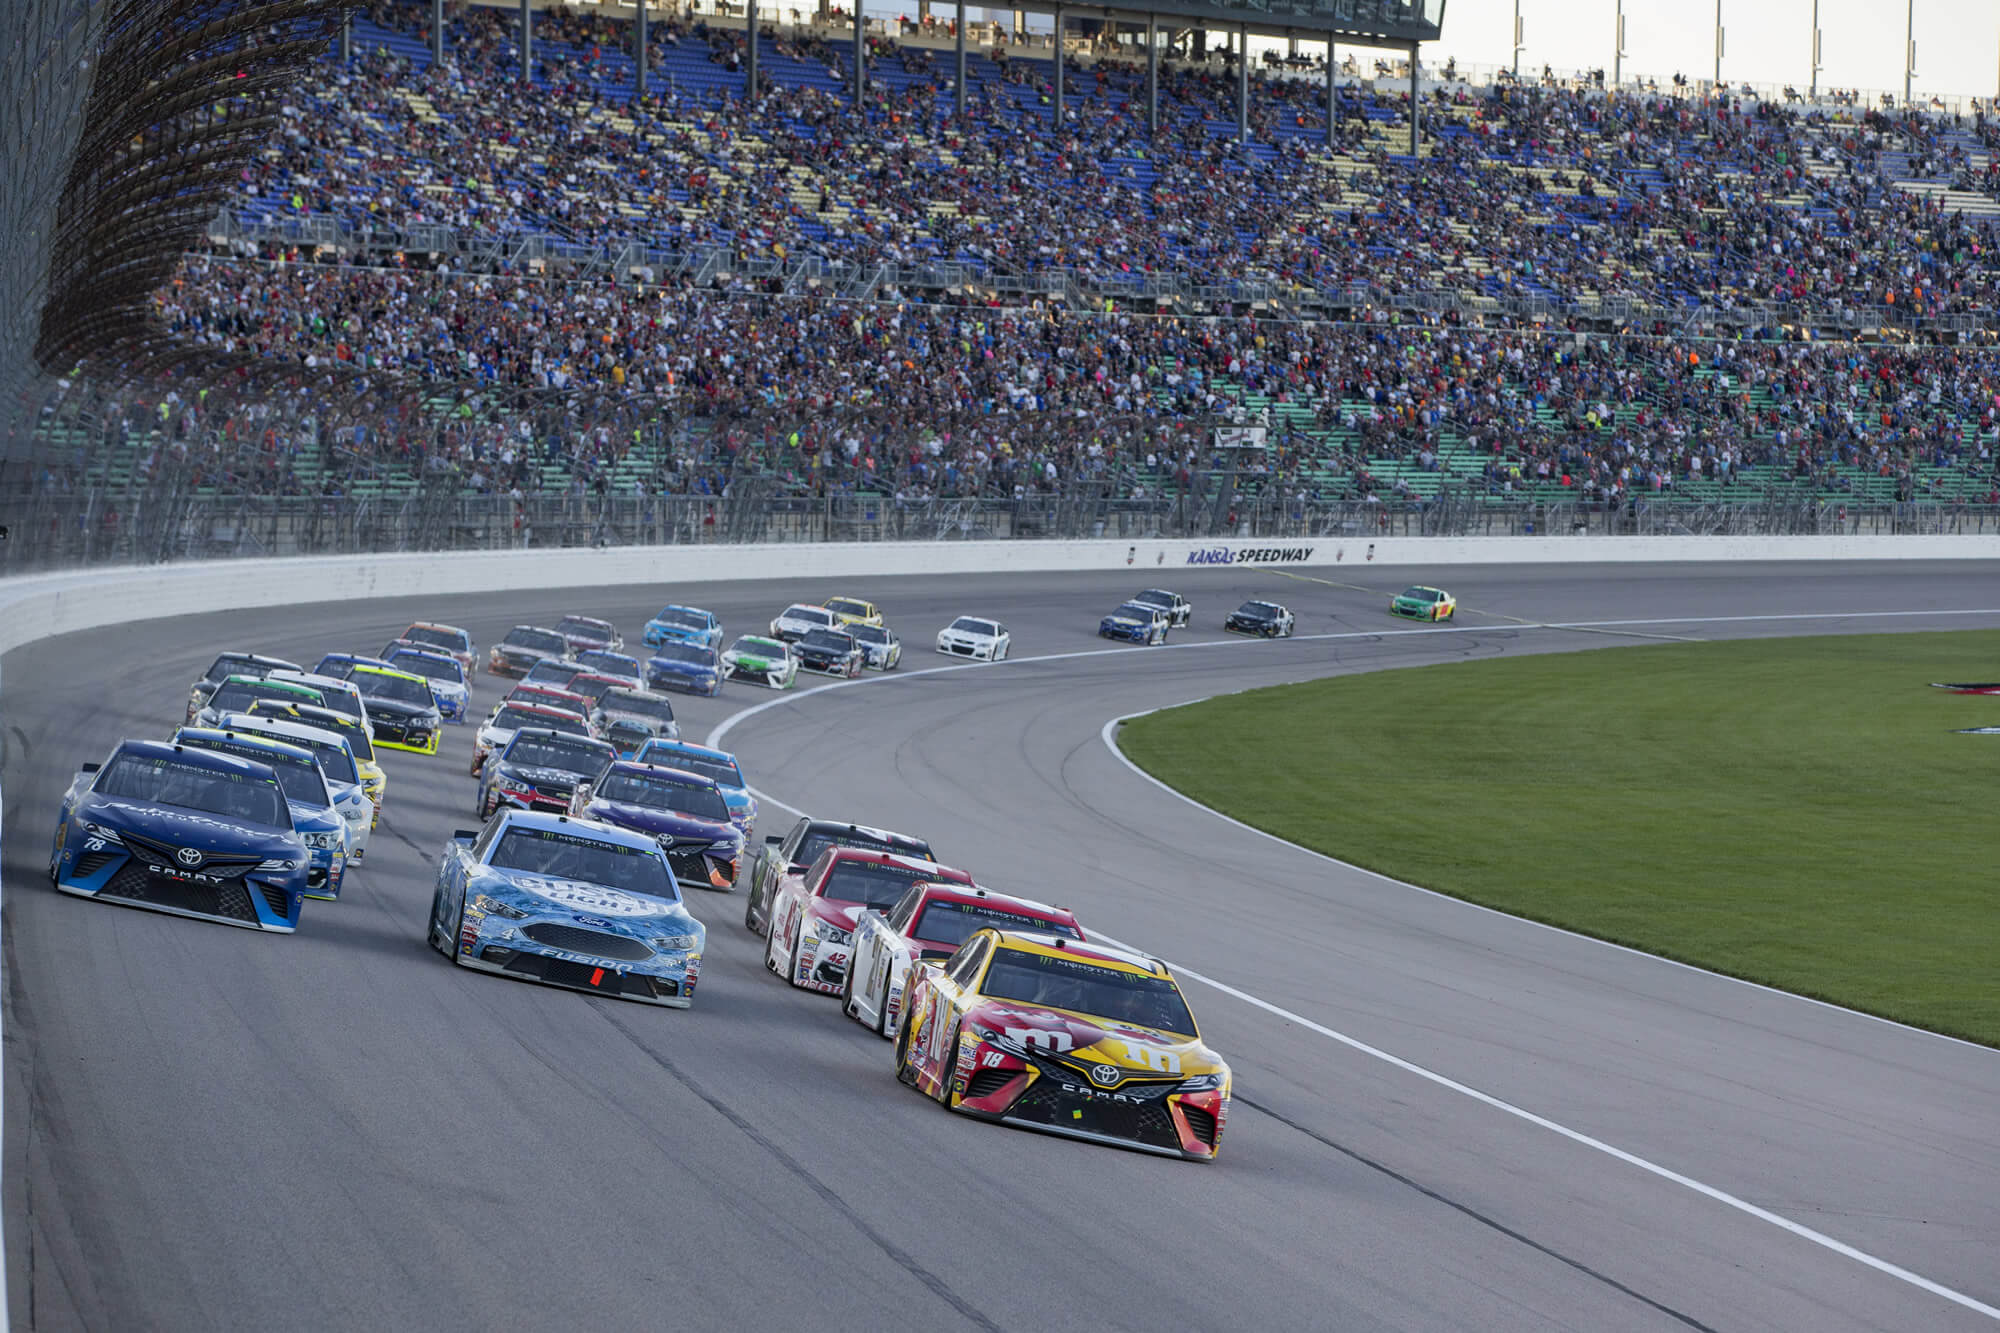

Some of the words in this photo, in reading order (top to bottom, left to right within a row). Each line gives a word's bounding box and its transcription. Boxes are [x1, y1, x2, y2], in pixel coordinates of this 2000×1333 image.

[1186, 546, 1236, 564] KANSAS
[1237, 547, 1314, 562] SPEEDWAY
[225, 744, 275, 758] MONSTER
[171, 762, 227, 778] MONSTER
[84, 836, 106, 851] 78
[558, 835, 614, 850] MONSTER
[149, 864, 224, 884] CAMRY
[881, 864, 930, 878] MONSTER
[578, 916, 606, 927] Ford
[977, 908, 1031, 923] MONSTER
[501, 928, 515, 940] 4
[828, 952, 847, 965] 42
[1056, 960, 1120, 977] MONSTER
[982, 1051, 1005, 1068] 18
[1062, 1083, 1145, 1105] CAMRY
